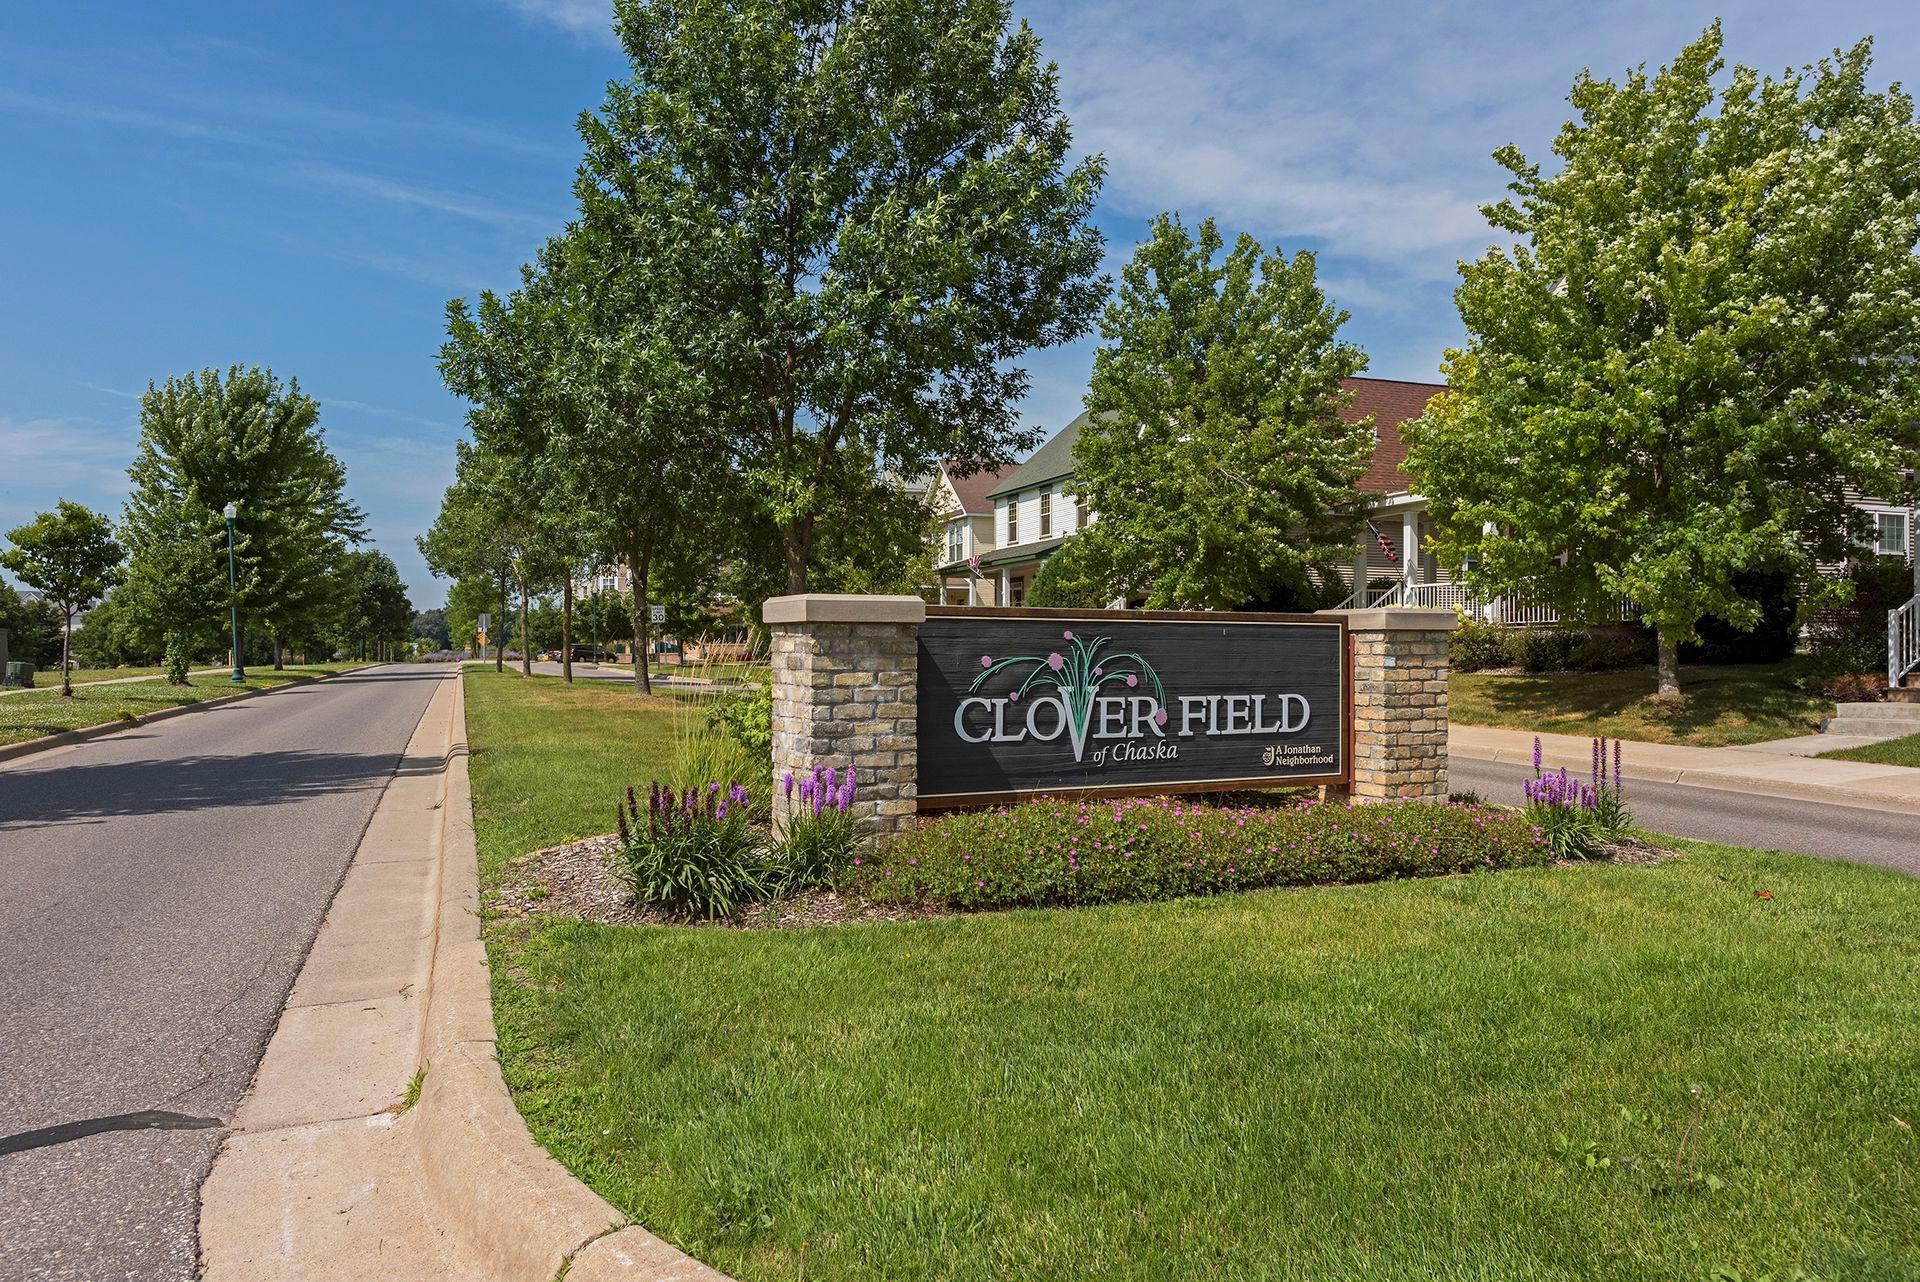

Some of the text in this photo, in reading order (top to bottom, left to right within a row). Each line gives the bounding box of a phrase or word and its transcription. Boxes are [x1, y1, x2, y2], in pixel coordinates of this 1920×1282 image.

[953, 685, 1311, 762] CLOVER FIELD
[1093, 739, 1179, 767] of Chaska
[1275, 744, 1321, 755] A Jonathan
[1275, 754, 1334, 767] Neighborhood
